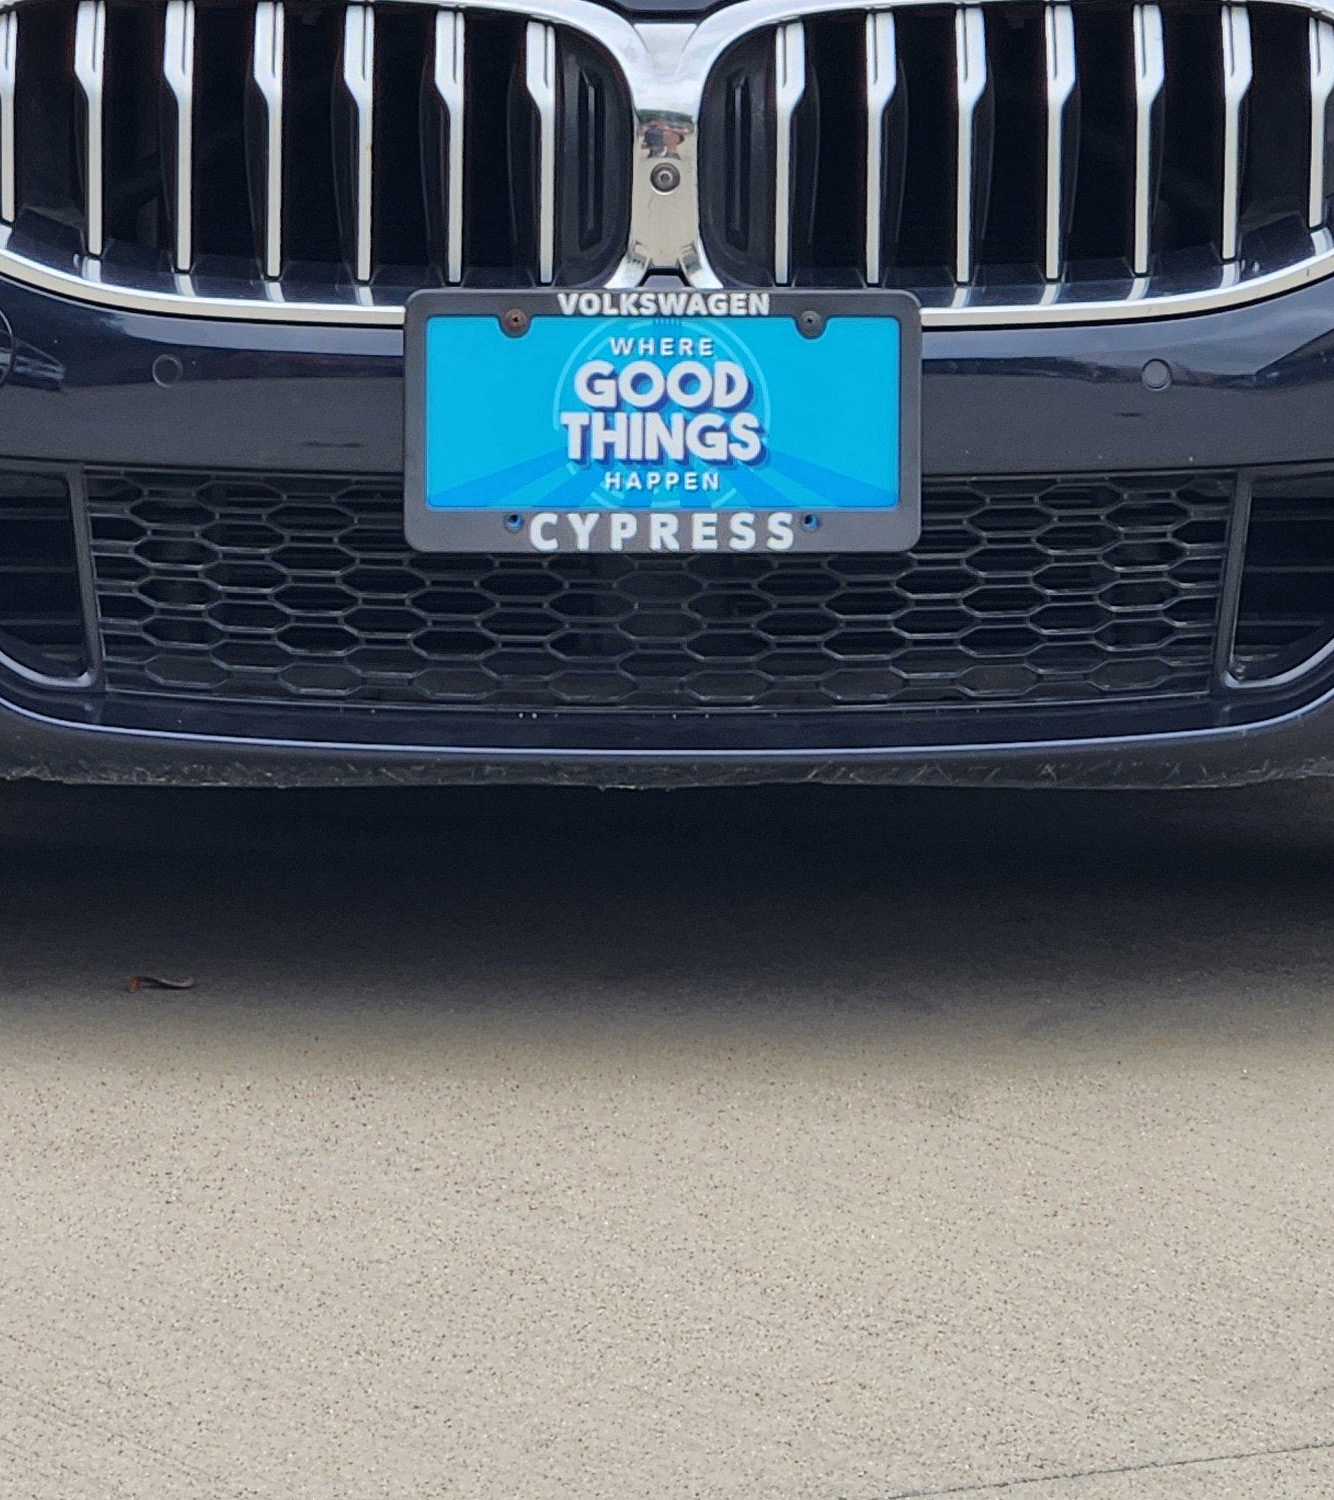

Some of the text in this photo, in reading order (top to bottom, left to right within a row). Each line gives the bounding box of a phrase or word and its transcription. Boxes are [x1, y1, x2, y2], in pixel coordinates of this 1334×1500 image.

[557, 293, 770, 316] VOLKSWAGEN
[609, 337, 714, 356] WHERE
[574, 360, 750, 409] GOOD
[560, 411, 764, 463] THINGS
[605, 472, 720, 492] HAPPEN
[529, 512, 795, 551] CYPRESS
